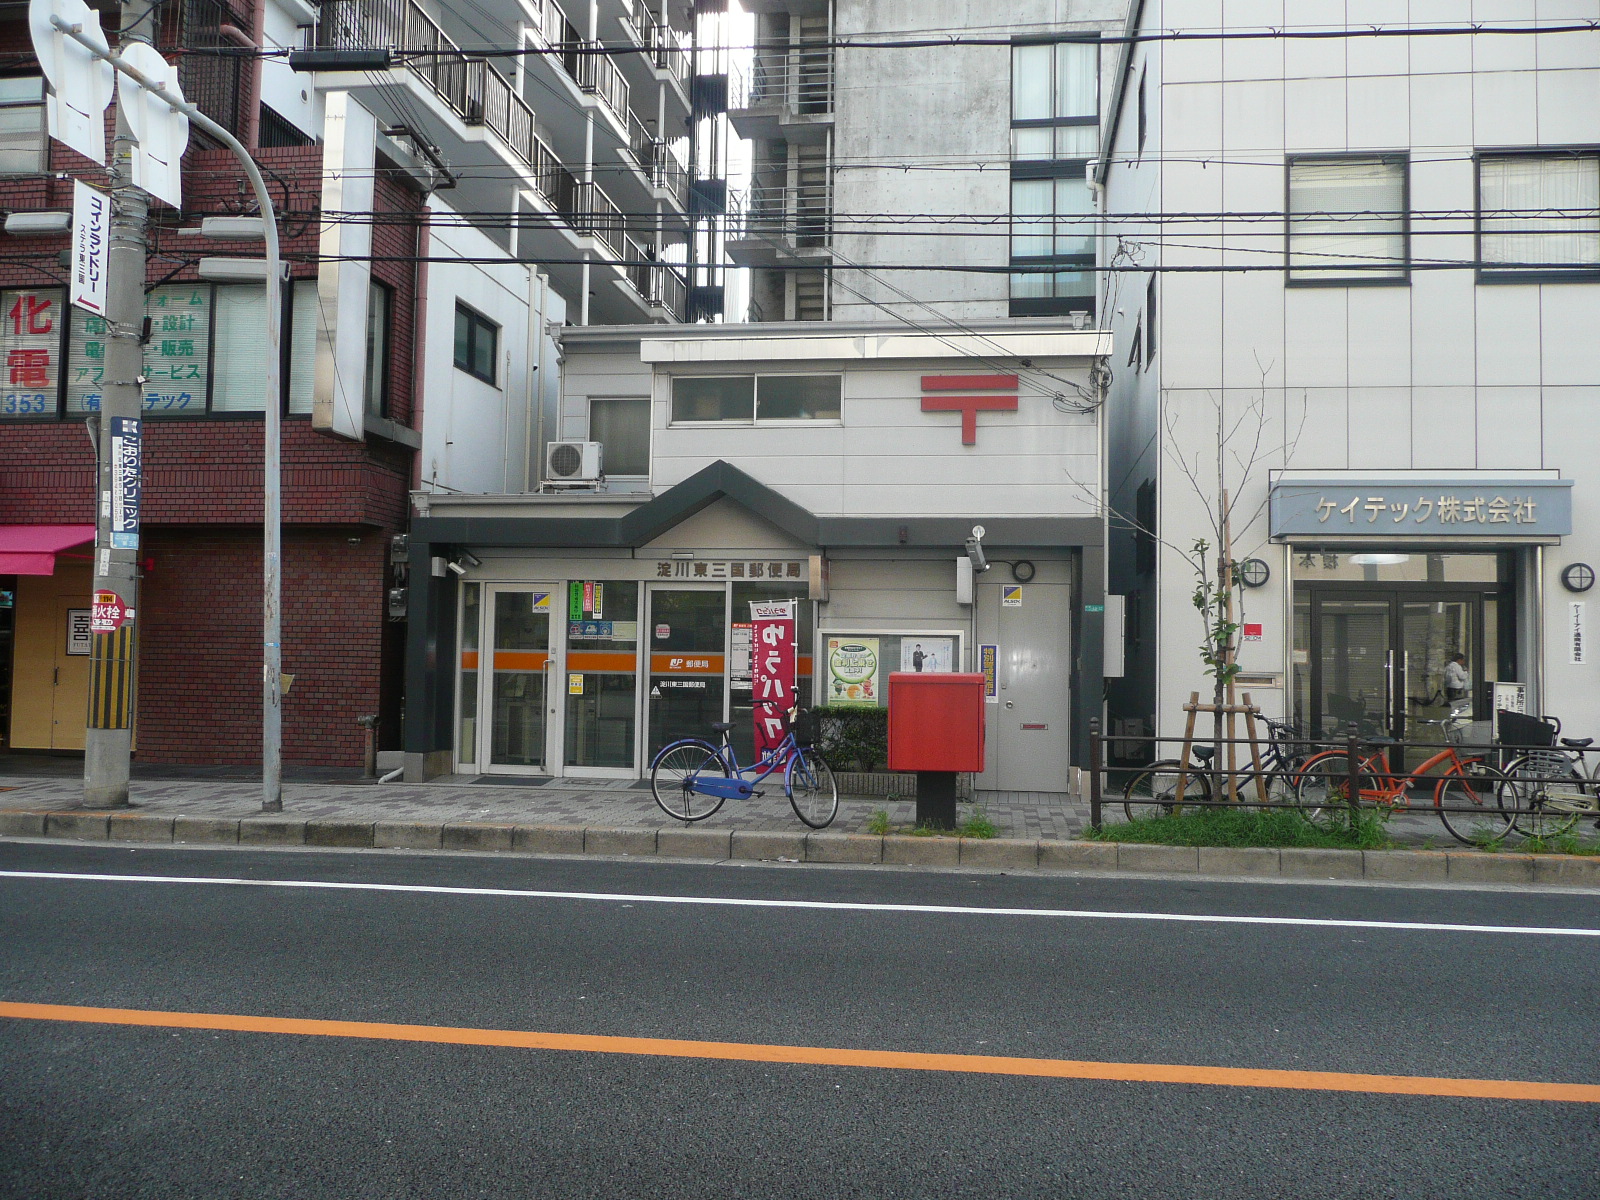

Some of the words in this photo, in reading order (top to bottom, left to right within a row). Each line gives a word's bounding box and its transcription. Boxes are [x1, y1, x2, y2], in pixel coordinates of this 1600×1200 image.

[89, 195, 103, 293] コインランドリー
[8, 295, 53, 390] 化電
[1315, 496, 1537, 524] ケイテック株式会社
[656, 562, 802, 580] 淀川東三国郵便局
[686, 660, 709, 669] 郵便局
[659, 680, 706, 689] 淀川東三国郵便局
